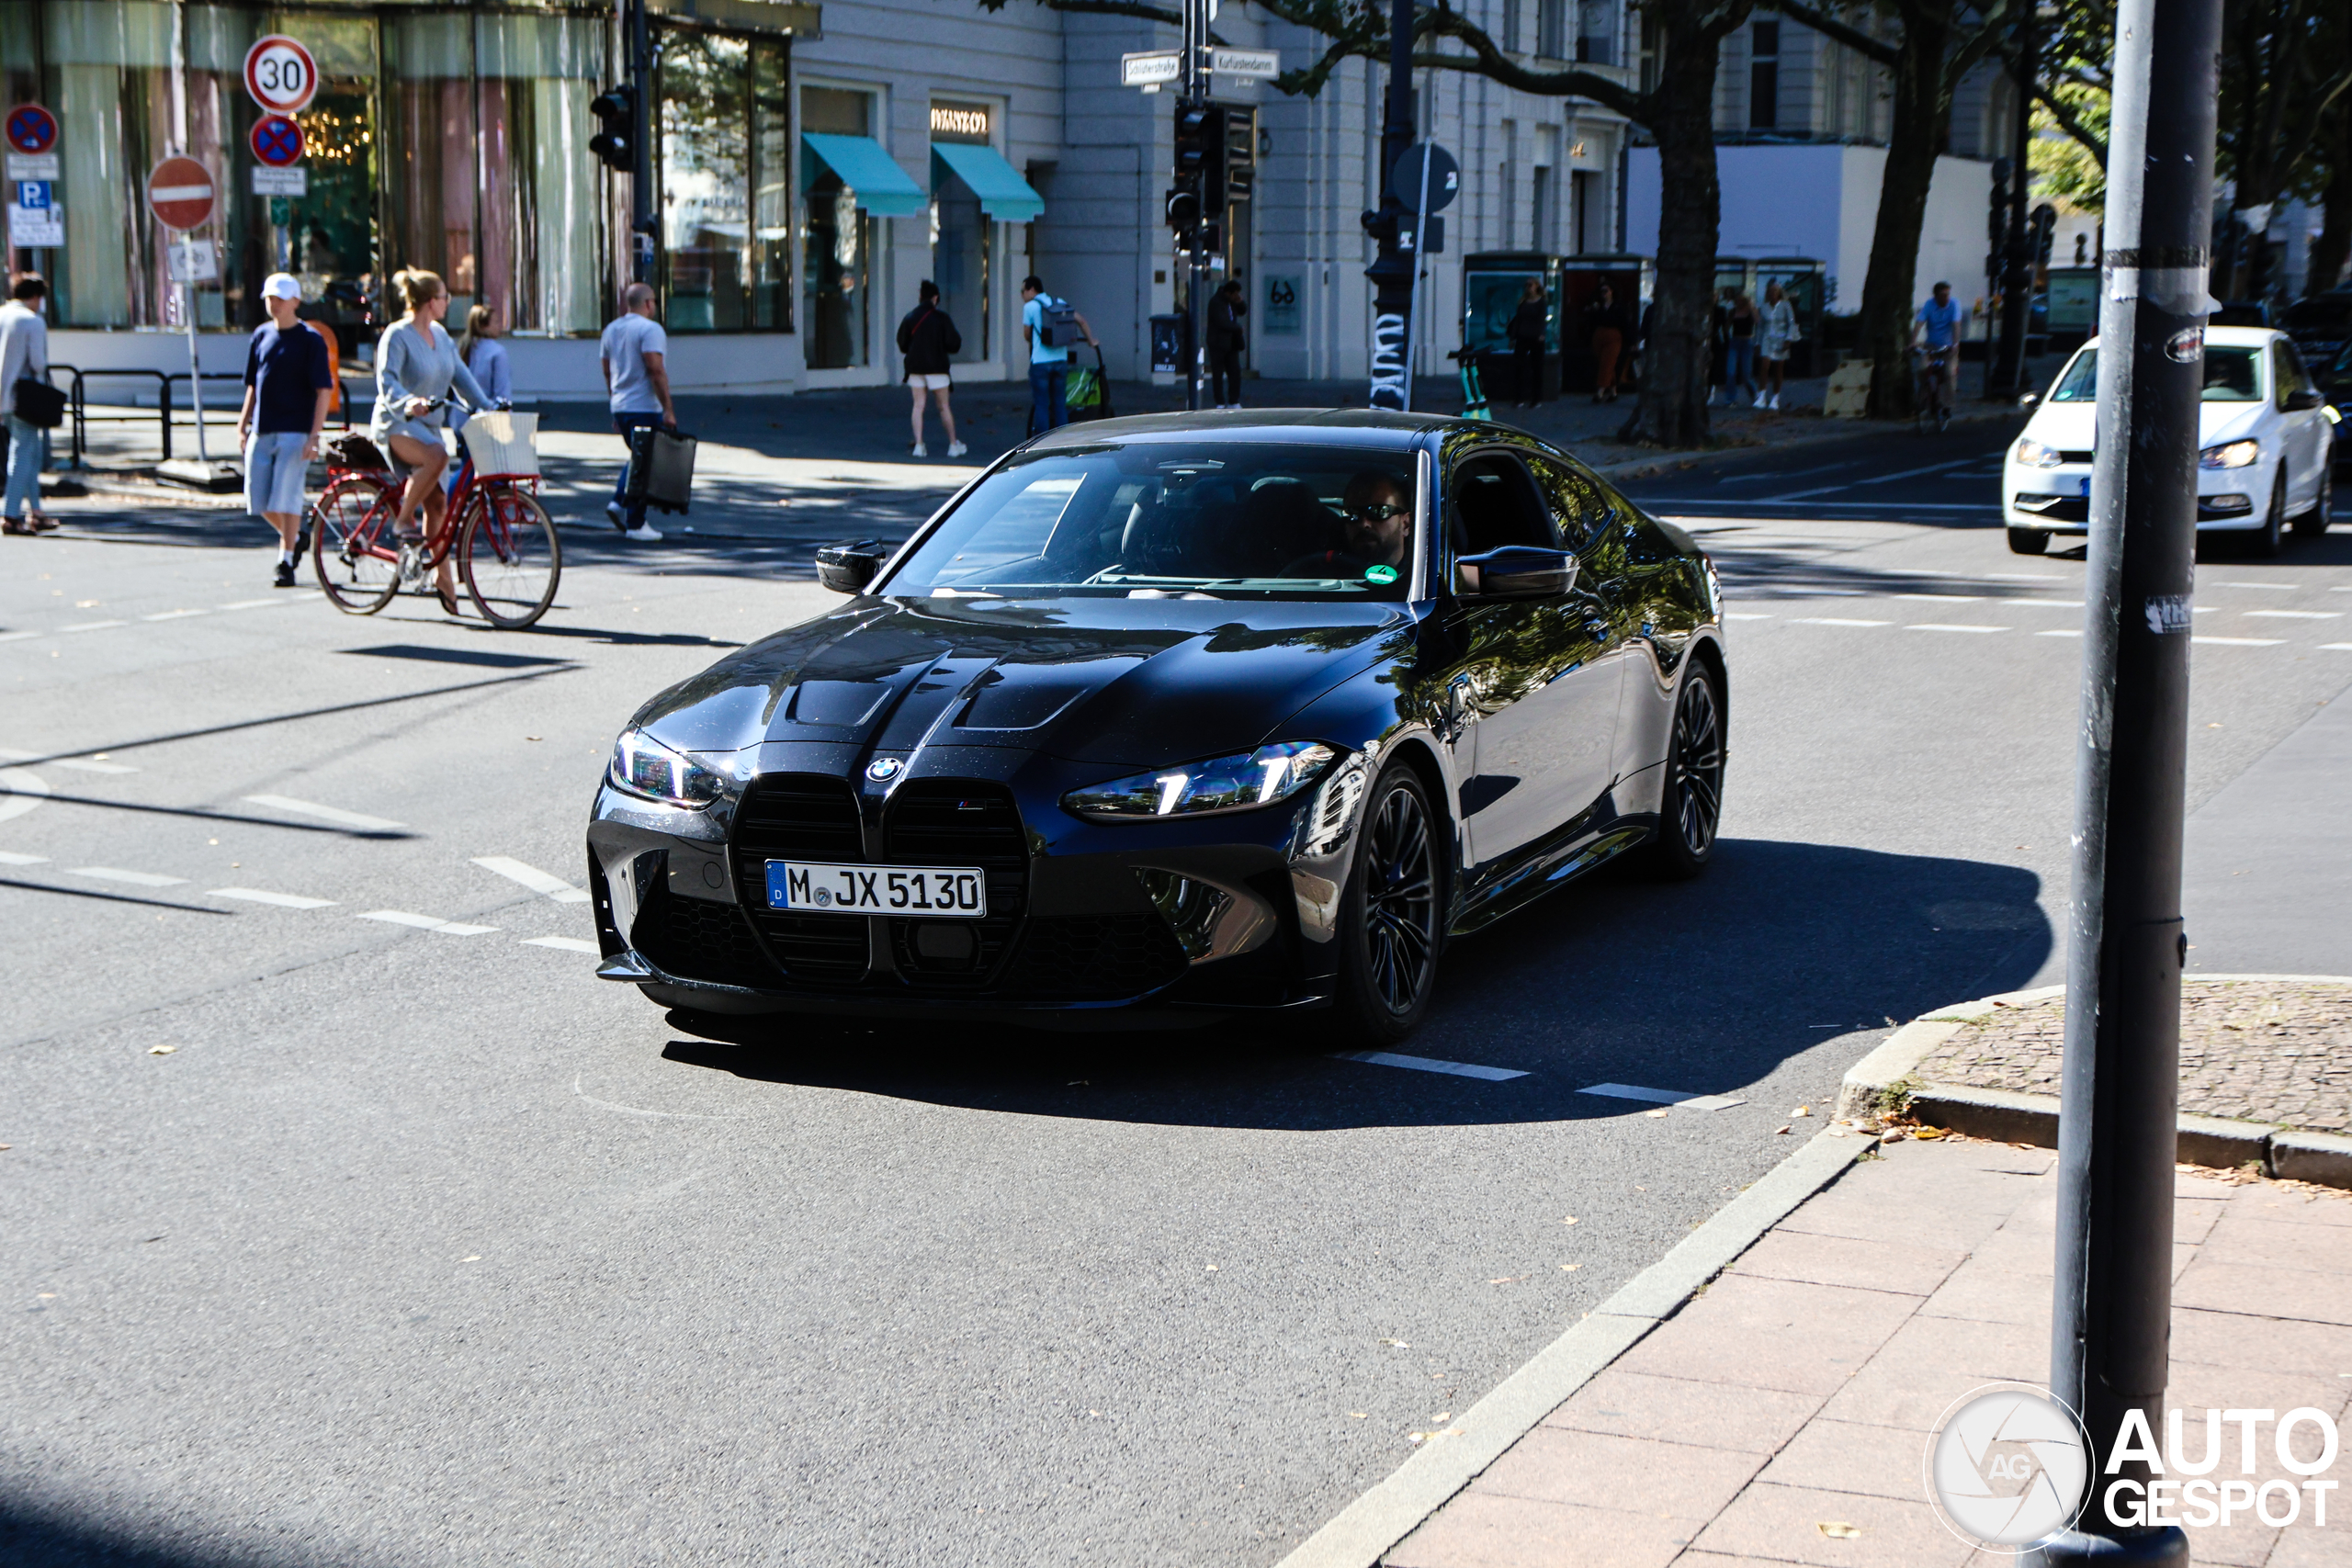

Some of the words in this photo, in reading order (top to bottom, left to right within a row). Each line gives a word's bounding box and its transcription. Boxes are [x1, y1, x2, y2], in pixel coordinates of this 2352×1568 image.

[262, 58, 300, 92] 30
[1377, 566, 1386, 574] 4
[774, 889, 783, 900] D
[788, 868, 810, 904] M
[835, 871, 880, 908] JX
[888, 873, 978, 909] 5130
